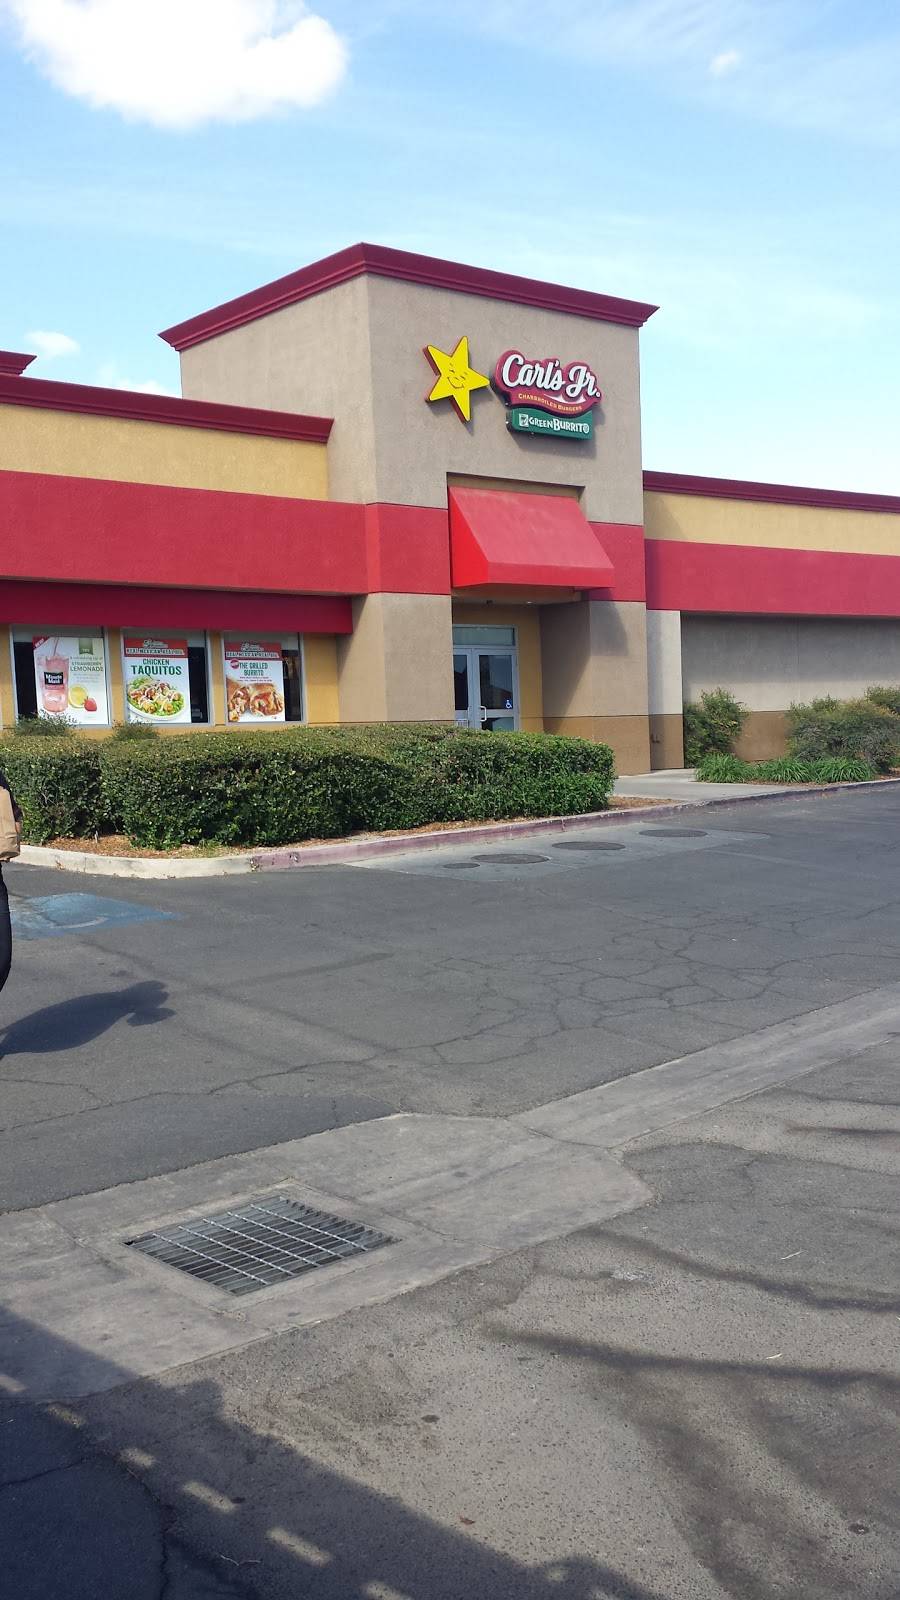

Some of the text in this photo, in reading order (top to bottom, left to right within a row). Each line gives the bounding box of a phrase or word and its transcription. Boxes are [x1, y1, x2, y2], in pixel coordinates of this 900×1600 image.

[502, 353, 601, 398] Carl's Jr.
[142, 658, 170, 666] CHICKEN
[249, 662, 269, 670] GRILLED
[130, 665, 182, 676] TAQUITOS
